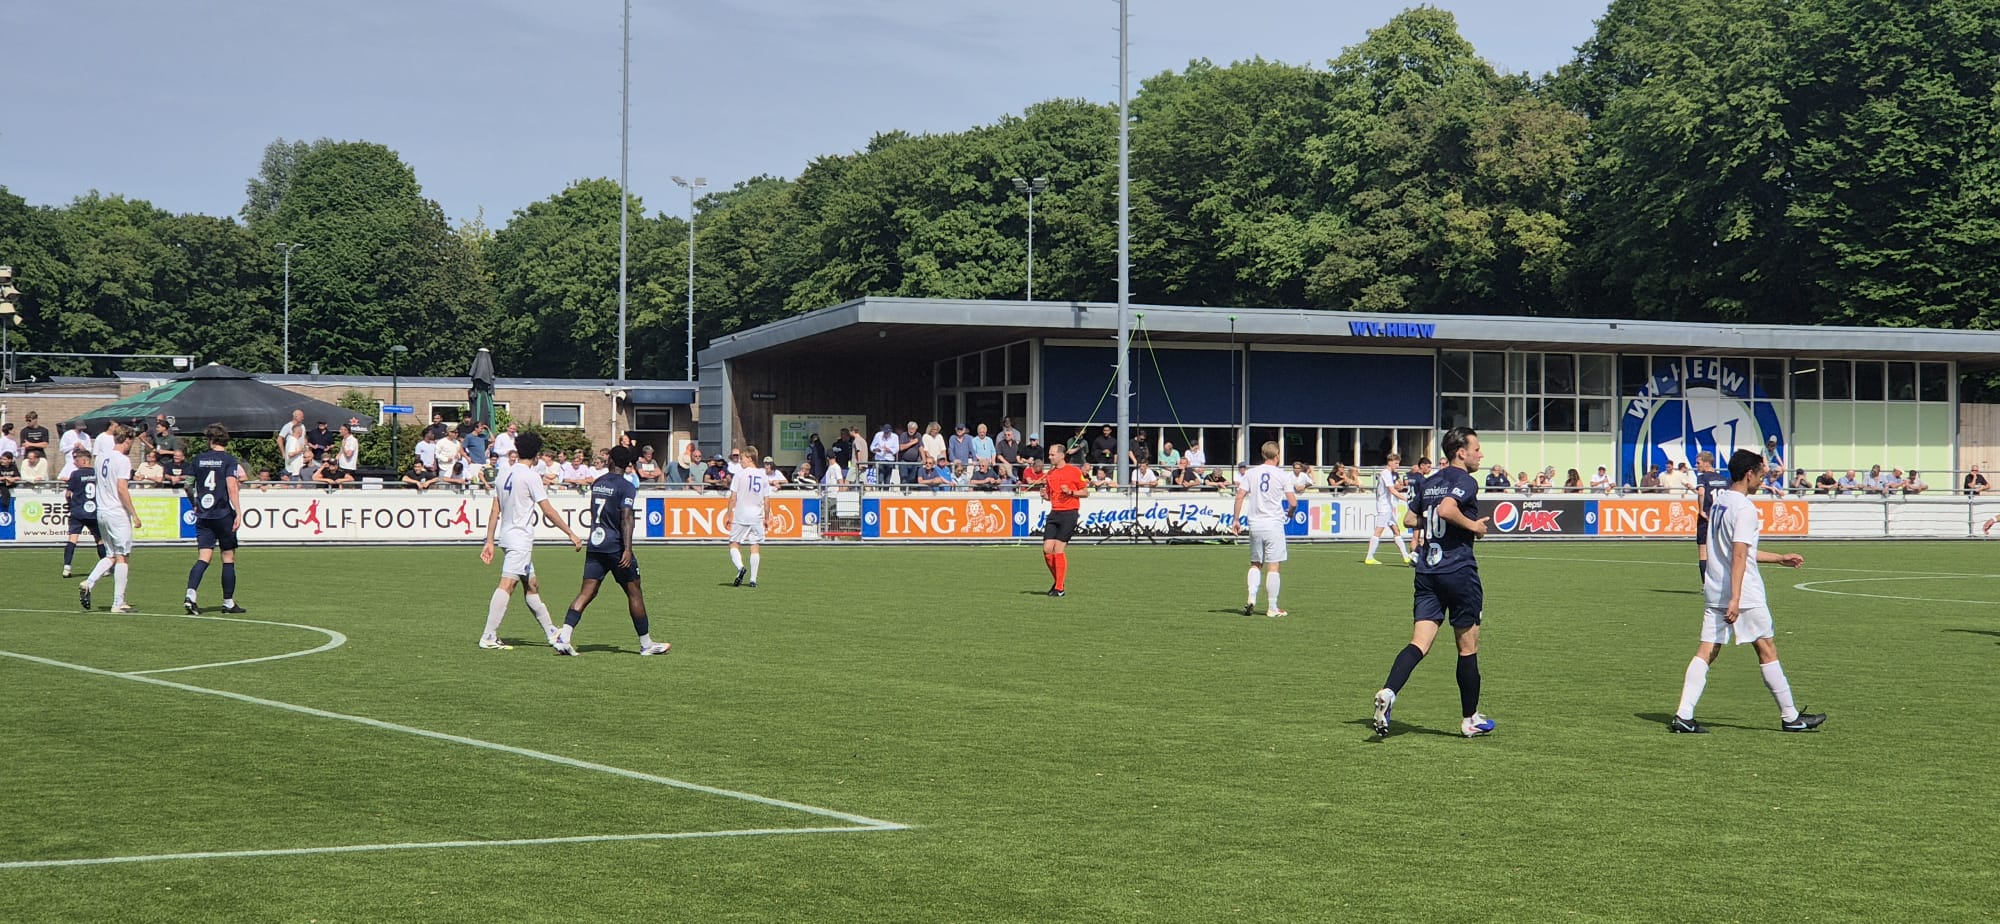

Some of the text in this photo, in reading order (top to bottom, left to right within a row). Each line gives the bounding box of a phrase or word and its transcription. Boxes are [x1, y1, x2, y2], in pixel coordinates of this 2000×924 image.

[1349, 320, 1436, 339] WV-HEDW
[102, 457, 110, 478] 6
[85, 482, 96, 499] 9
[204, 470, 216, 491] 4
[503, 472, 513, 496] 4
[749, 475, 761, 493] 15
[1259, 473, 1271, 493] 8
[595, 498, 606, 524] 7
[887, 506, 956, 534] ING
[1086, 507, 1138, 527] staat
[1145, 502, 1169, 520] de
[1220, 512, 1249, 527] ma
[1423, 504, 1447, 540] 10
[1519, 510, 1564, 532] MAX
[1603, 507, 1661, 533] ING
[1711, 504, 1728, 538] 17
